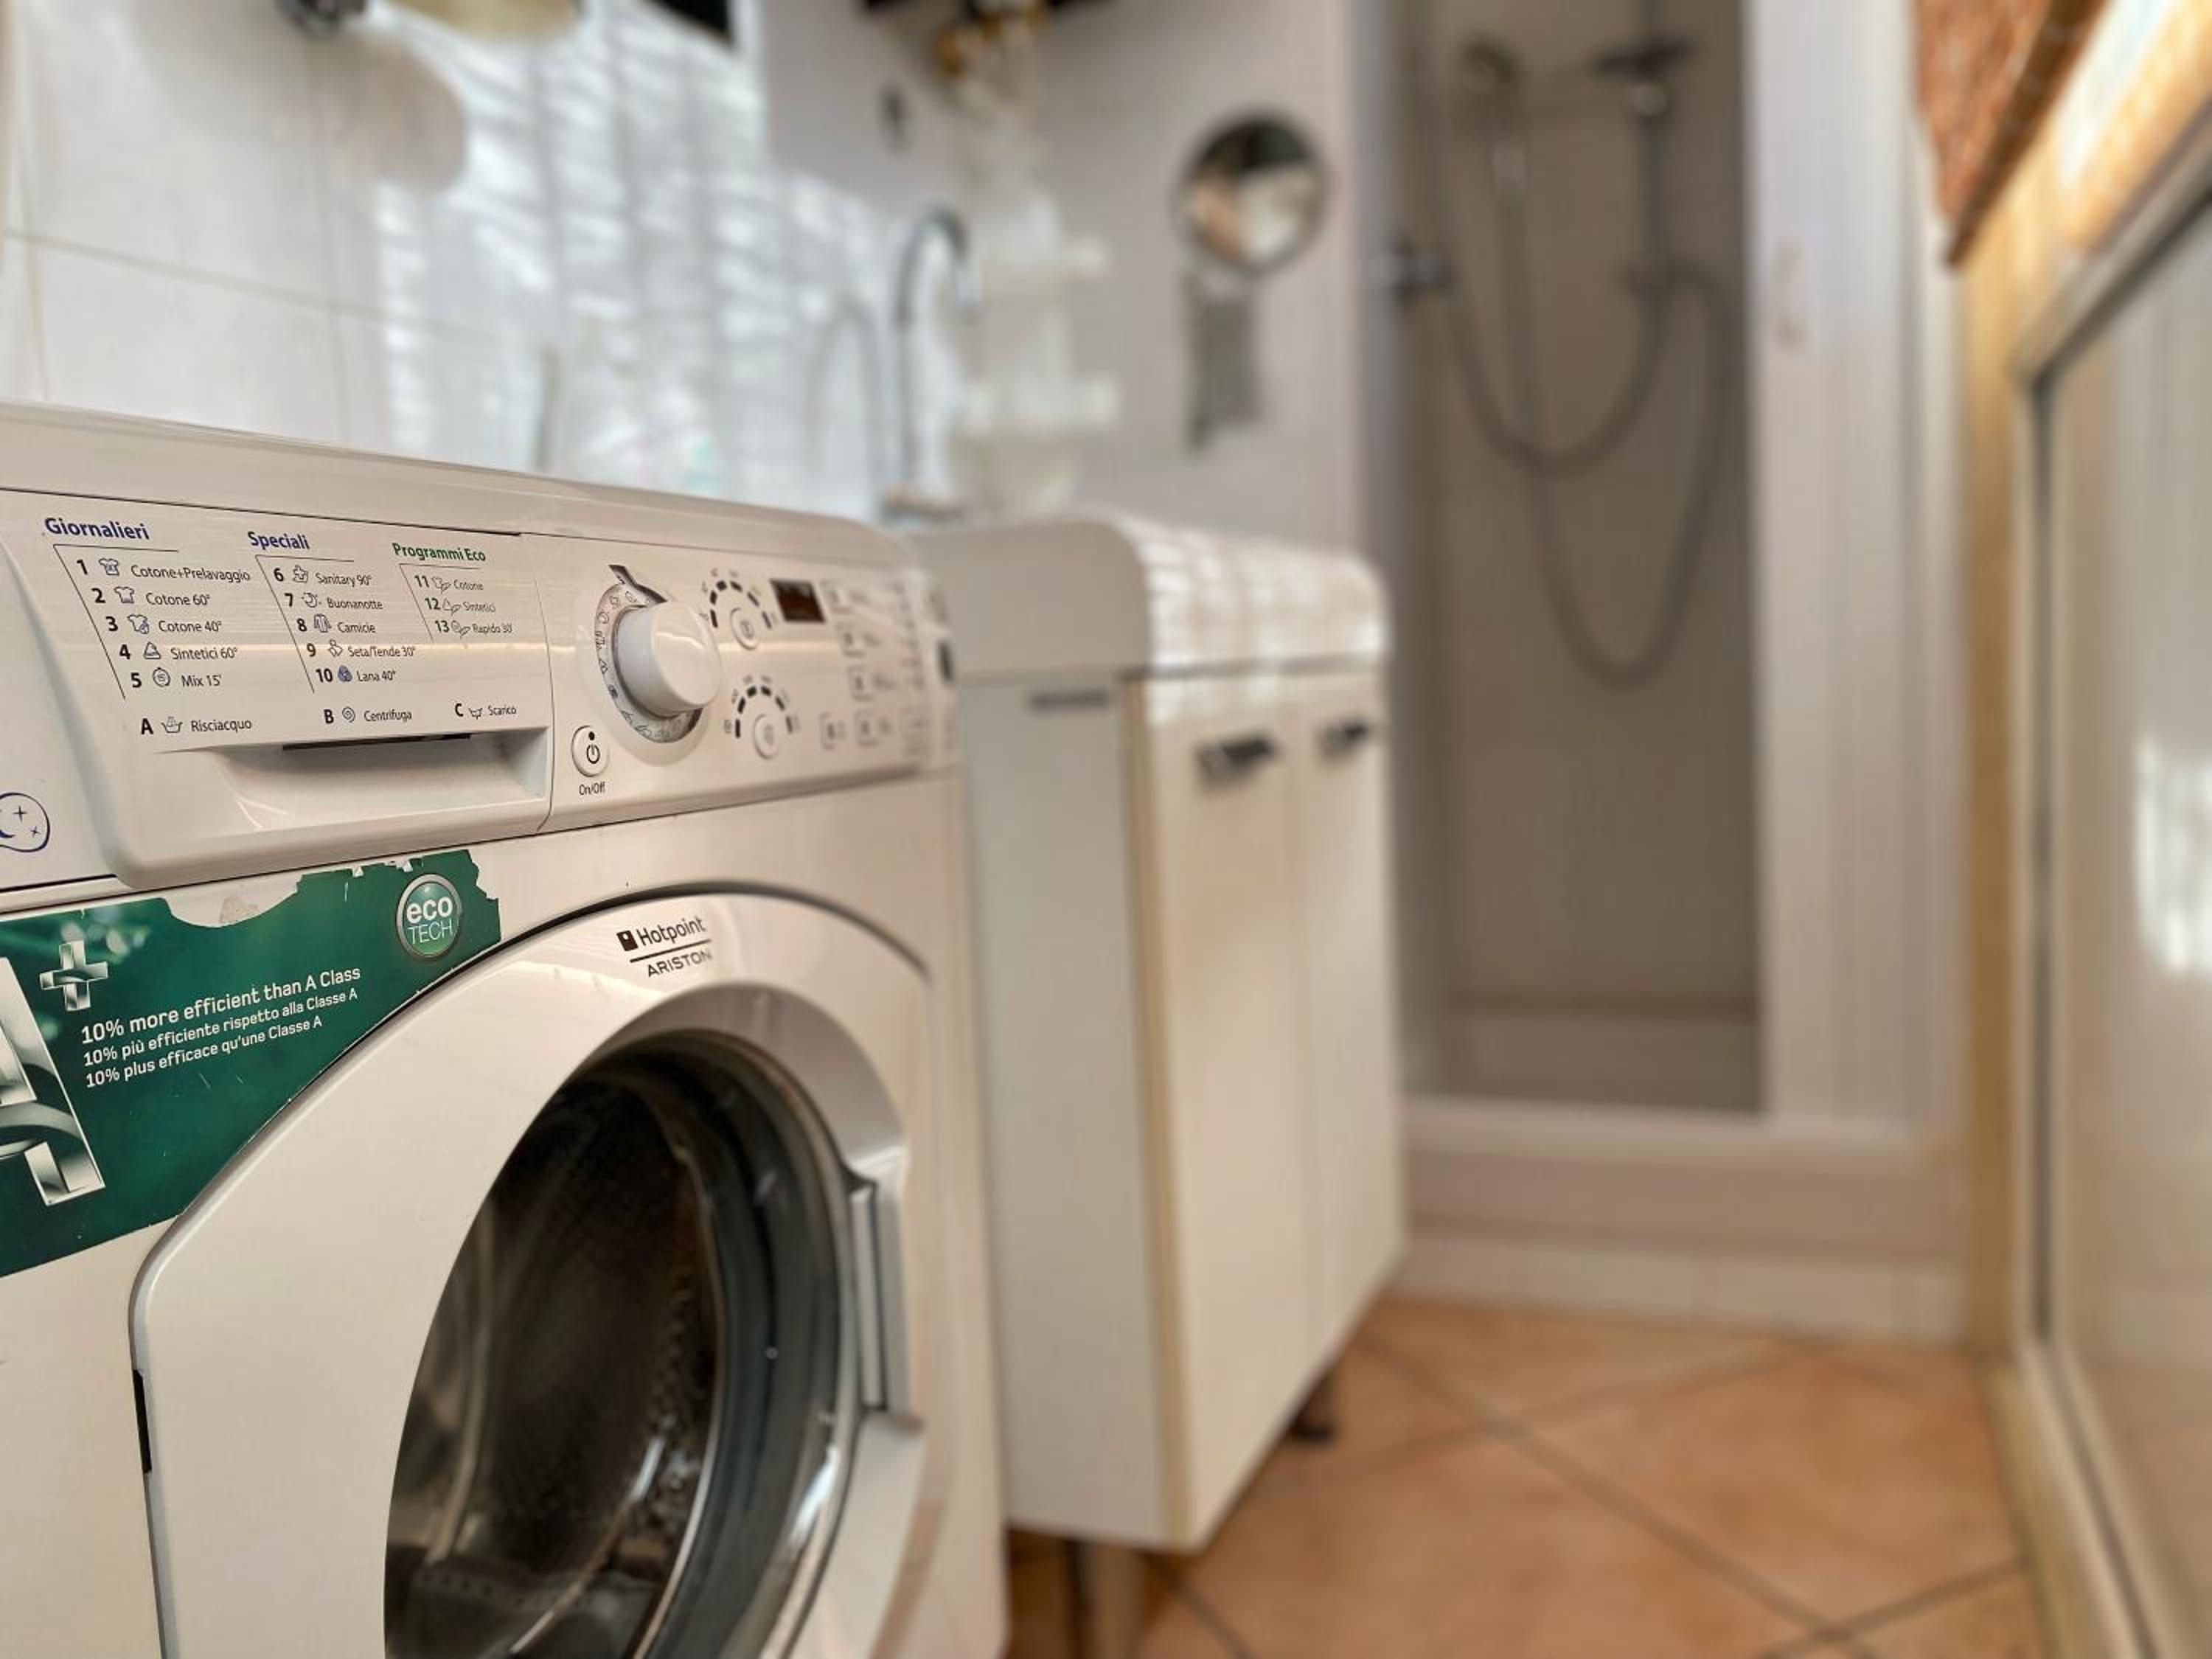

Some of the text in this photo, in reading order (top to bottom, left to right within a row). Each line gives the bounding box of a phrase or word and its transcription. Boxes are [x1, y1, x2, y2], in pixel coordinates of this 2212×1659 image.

[45, 518, 149, 540] Giornalieri
[248, 531, 310, 550] Speciali
[392, 543, 486, 561] Programmi Eco
[77, 560, 251, 582] 1 Cotone+Prelavaggio
[274, 568, 284, 582] 6
[316, 573, 355, 587] Sanitary
[414, 575, 429, 588] 11
[91, 588, 105, 603] 2
[146, 593, 190, 605] Cotone
[285, 593, 383, 609] 7 Buonanotte
[425, 597, 441, 610] 12
[105, 616, 118, 631] 3
[159, 620, 202, 632] Cotone
[296, 618, 376, 633] 8 Camicie
[435, 620, 450, 633] 13
[119, 644, 131, 659] 4
[170, 647, 218, 659] Sintetici
[307, 643, 316, 657] 9
[131, 672, 142, 688] 5
[181, 675, 204, 686] Mix
[316, 668, 333, 683] 10
[357, 670, 380, 681] Lana
[324, 709, 412, 724] B Centrifuga
[455, 703, 517, 717] C Scarico
[141, 718, 251, 734] A Risciacquo
[406, 897, 453, 923] eco
[408, 918, 453, 944] TECH
[636, 917, 706, 946] Hotpoint
[648, 948, 712, 977] ARISTON
[81, 967, 361, 1044] 10% more efficient than A Class
[83, 988, 358, 1067] 10% più efficiente rispetto alla Classe A
[86, 1015, 322, 1088] 10% plus efficace qu'une Classe A
